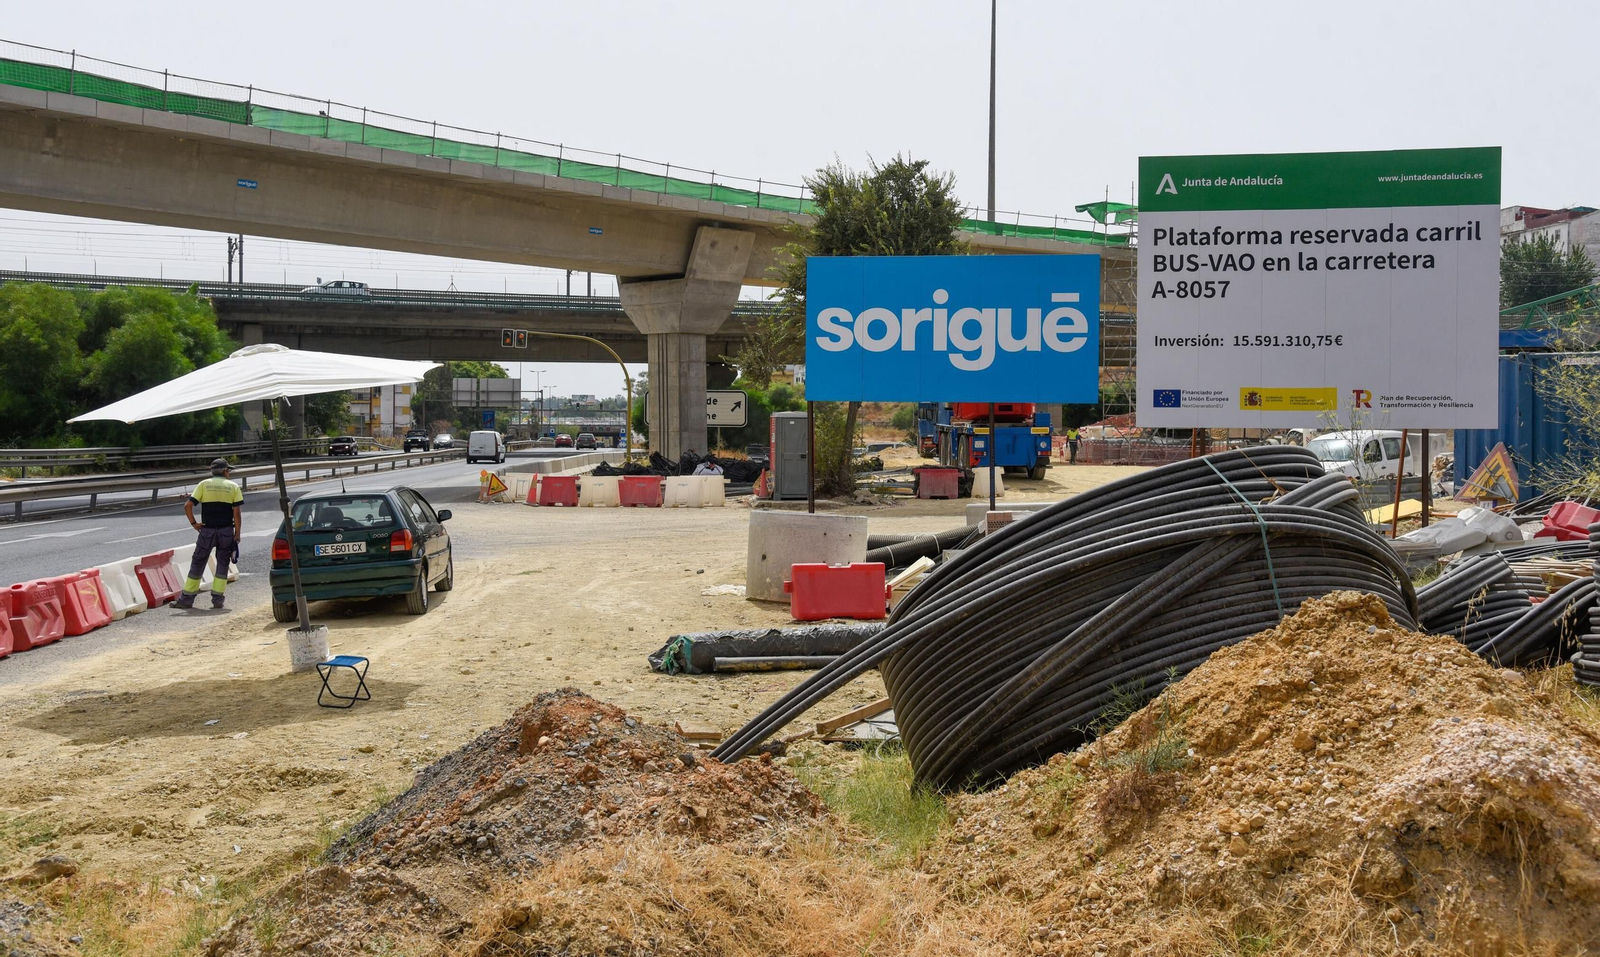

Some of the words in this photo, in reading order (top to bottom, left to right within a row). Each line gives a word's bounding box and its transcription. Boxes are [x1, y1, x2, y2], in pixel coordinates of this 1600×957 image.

[1182, 177, 1212, 187] Junta
[1214, 177, 1227, 186] de
[1229, 174, 1283, 186] Andalucía
[1378, 172, 1483, 183] www.juntadeandalucia.es
[1153, 225, 1282, 246] Plataforma
[1290, 223, 1408, 245] reservada
[1416, 220, 1481, 242] carril
[1153, 253, 1255, 273] BUS-VAO
[1262, 256, 1290, 272] en
[1298, 251, 1318, 271] la
[1325, 251, 1435, 271] carretera
[1151, 280, 1230, 299] A-8057
[1154, 333, 1224, 347] Inversión:
[320, 545, 330, 554] SE
[331, 544, 350, 554] 5601
[352, 543, 362, 552] CX
